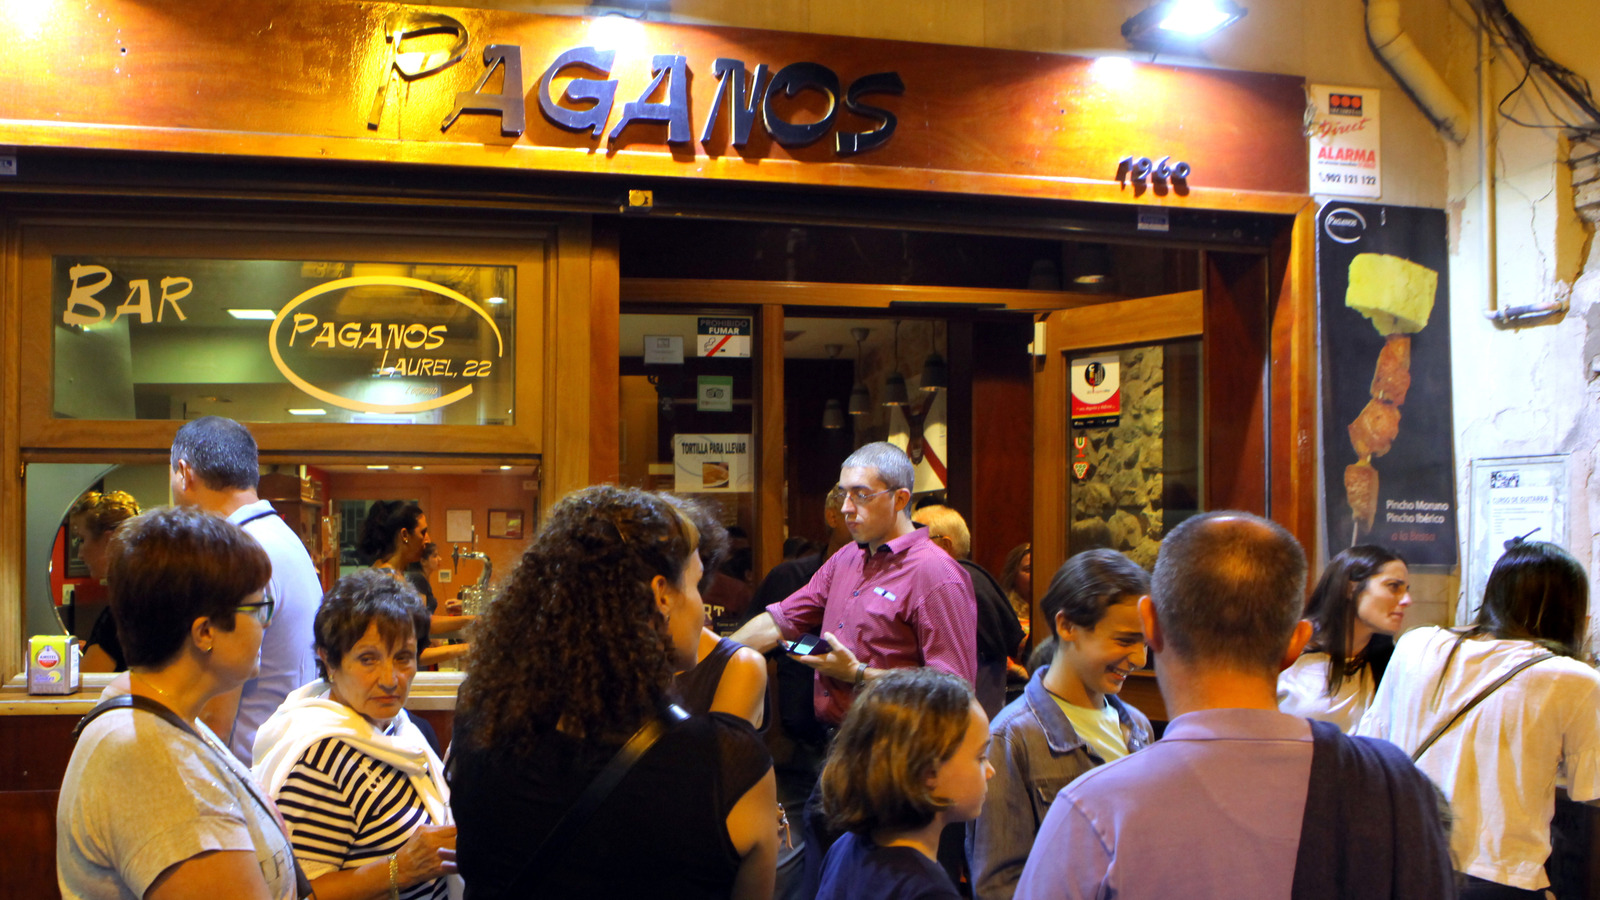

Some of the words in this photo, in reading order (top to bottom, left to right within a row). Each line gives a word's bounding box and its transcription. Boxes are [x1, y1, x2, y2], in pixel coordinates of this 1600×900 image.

[368, 11, 905, 155] PAGANOS
[1319, 118, 1371, 138] Direct
[1318, 147, 1376, 163] ALARMA
[1116, 155, 1191, 180] 1960
[1325, 173, 1341, 183] 902
[1344, 174, 1358, 184] 121
[1361, 176, 1377, 185] 122
[63, 263, 193, 327] BAR
[289, 313, 448, 350] PAGANOS
[700, 319, 748, 328] PROHIBIDO
[708, 327, 740, 335] FUMAR
[378, 350, 458, 378] LAUREL,
[462, 360, 492, 377] 22
[681, 442, 708, 454] TORTILLA
[709, 442, 724, 454] PARA
[725, 442, 746, 454] LLEVAR
[1386, 500, 1415, 511] Pincho
[1415, 501, 1449, 511] Moruno
[1387, 513, 1415, 523] Pincho
[1415, 513, 1445, 524] Ibérico
